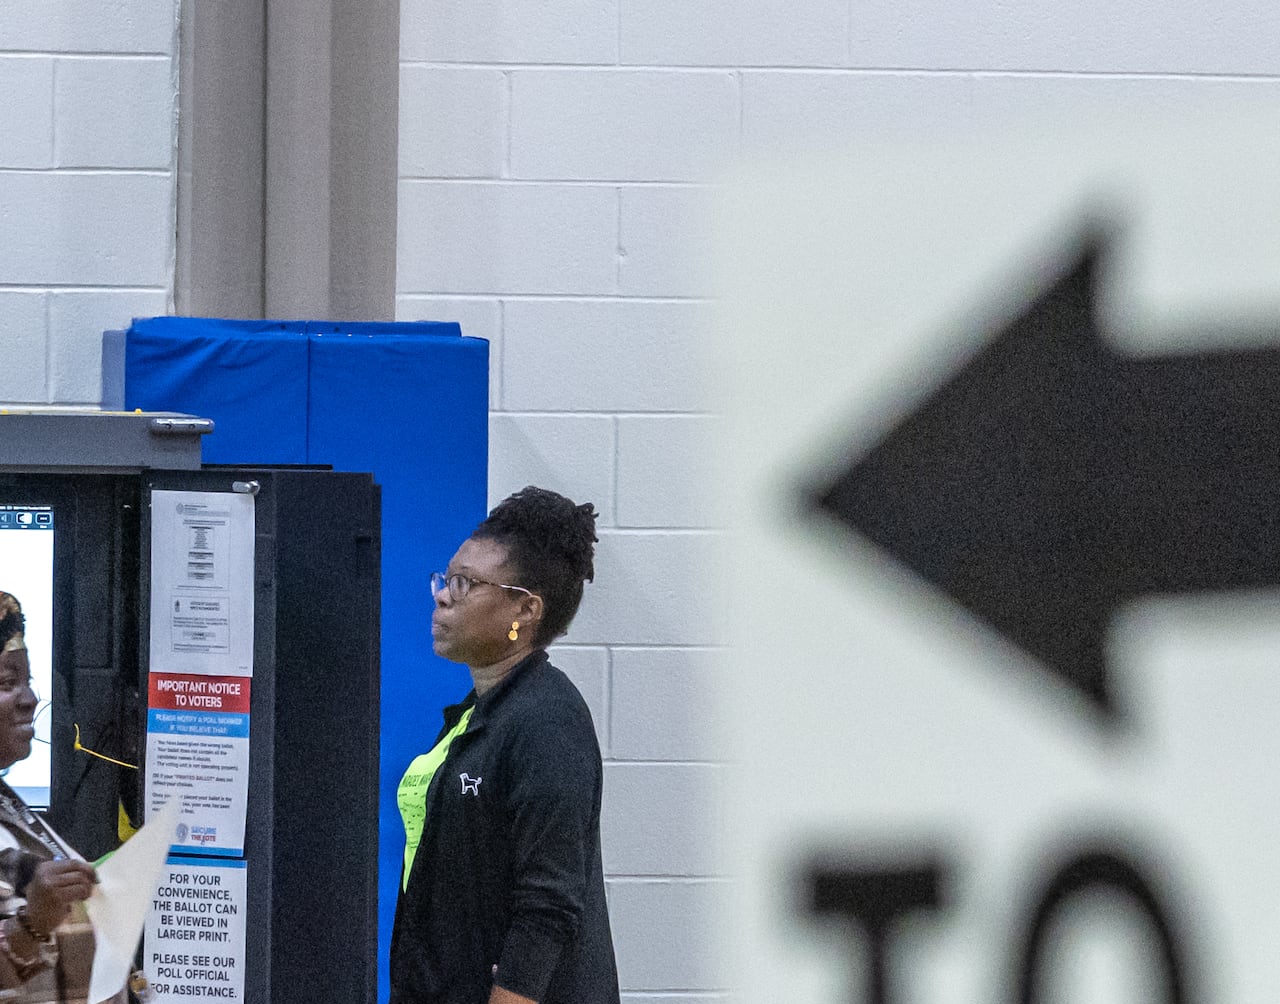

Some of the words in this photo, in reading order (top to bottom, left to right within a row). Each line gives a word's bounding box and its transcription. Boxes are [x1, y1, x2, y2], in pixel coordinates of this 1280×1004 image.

[157, 680, 207, 693] IMPORTANT
[209, 683, 240, 695] NOTICE
[175, 695, 187, 706] TO
[189, 696, 222, 707] VOTERS
[156, 714, 176, 722] PLEASE
[177, 715, 196, 723] NOTIFY
[170, 873, 189, 885] FOR
[193, 875, 220, 886] YOUR
[158, 887, 232, 901] CONVENIENCE,
[153, 900, 171, 911] THE
[174, 902, 212, 914] BALLOT
[216, 904, 237, 915] CAN
[161, 915, 173, 925] BE
[176, 916, 214, 928] VIEWED
[217, 918, 228, 928] IN
[158, 928, 195, 940] LARGER
[199, 931, 231, 942] PRINT.
[153, 953, 189, 966] PLEASE
[192, 955, 210, 966] SEE
[213, 957, 235, 968] OUR
[158, 967, 182, 979] POLL
[185, 969, 229, 981] OFFICIAL
[173, 984, 237, 998] ASSISTANCE.
